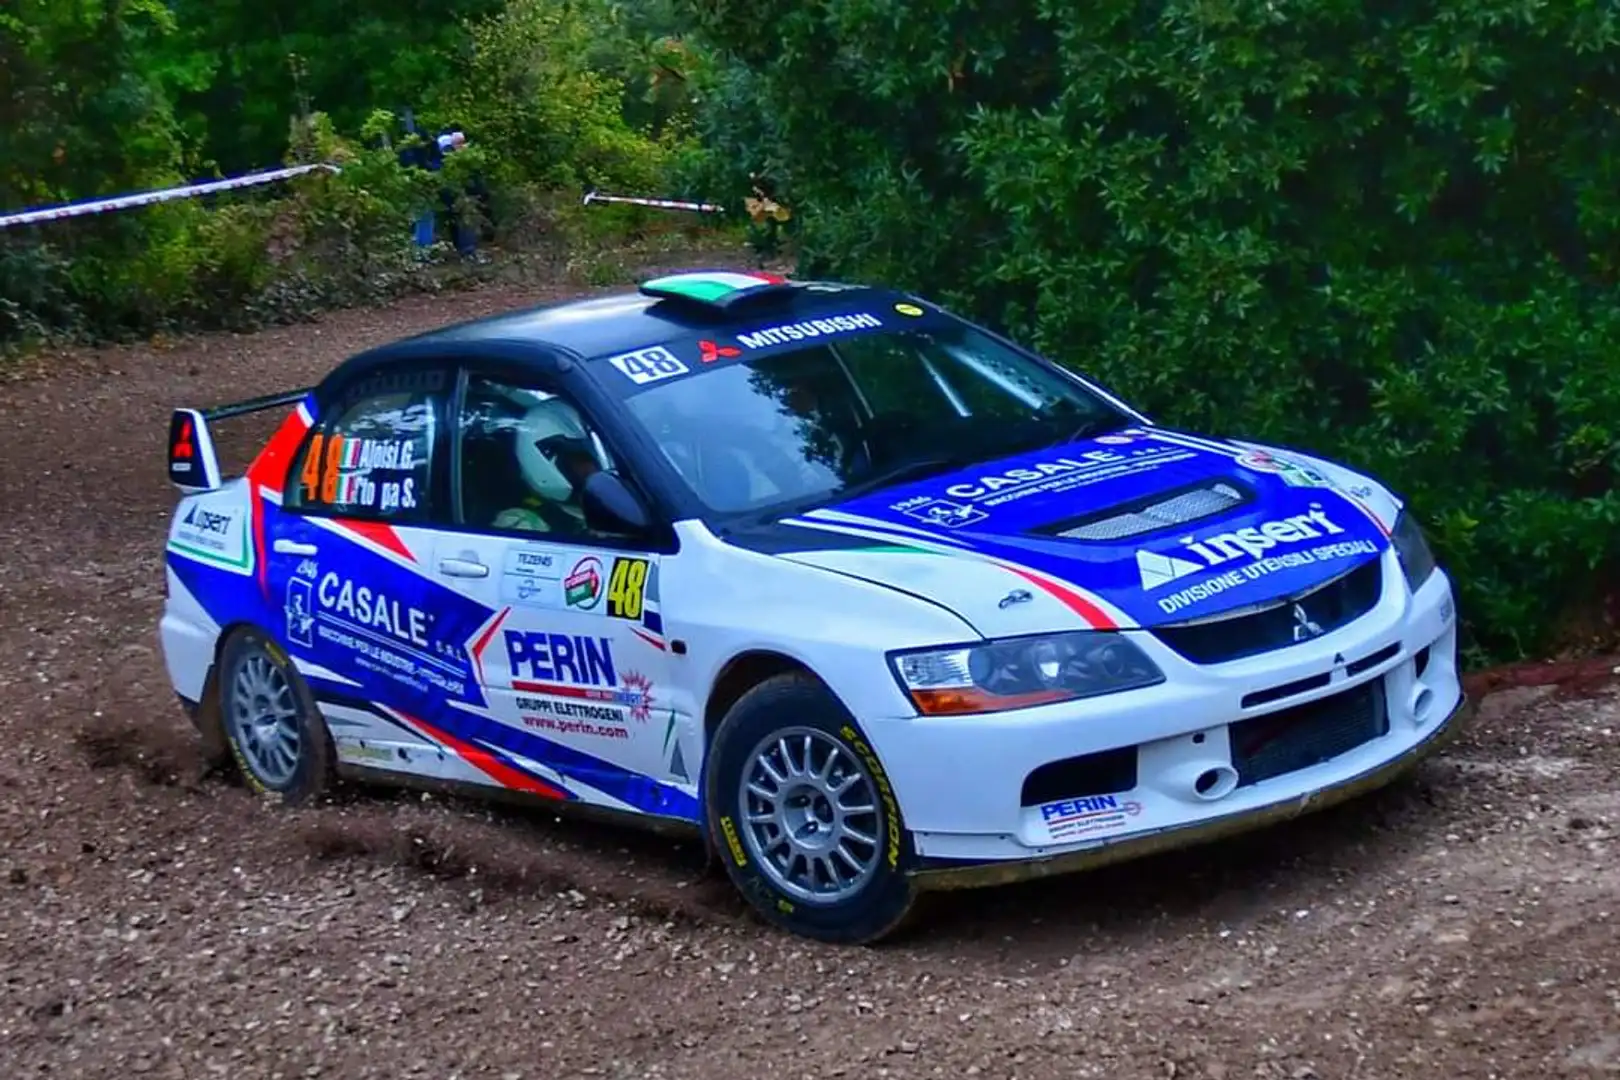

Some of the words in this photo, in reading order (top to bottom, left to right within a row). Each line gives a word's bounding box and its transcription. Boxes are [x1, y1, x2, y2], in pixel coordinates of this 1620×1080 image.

[620, 350, 681, 377] 48
[736, 313, 882, 350] MITSUBISHI
[301, 433, 345, 503] 48
[946, 450, 1126, 498] CASALE
[609, 559, 646, 618] 48
[1158, 569, 1247, 614] DIVISIONE
[1242, 549, 1315, 579] UTENSILI
[1311, 540, 1378, 562] SPECIALI
[318, 571, 429, 647] CASALE
[504, 629, 617, 687] PERIN
[515, 697, 553, 713] GRUPPI
[553, 701, 625, 722] ELETTROGENI
[521, 715, 629, 739] www.perin.com
[840, 725, 899, 868] SCORPION
[1041, 796, 1118, 820] PERIN
